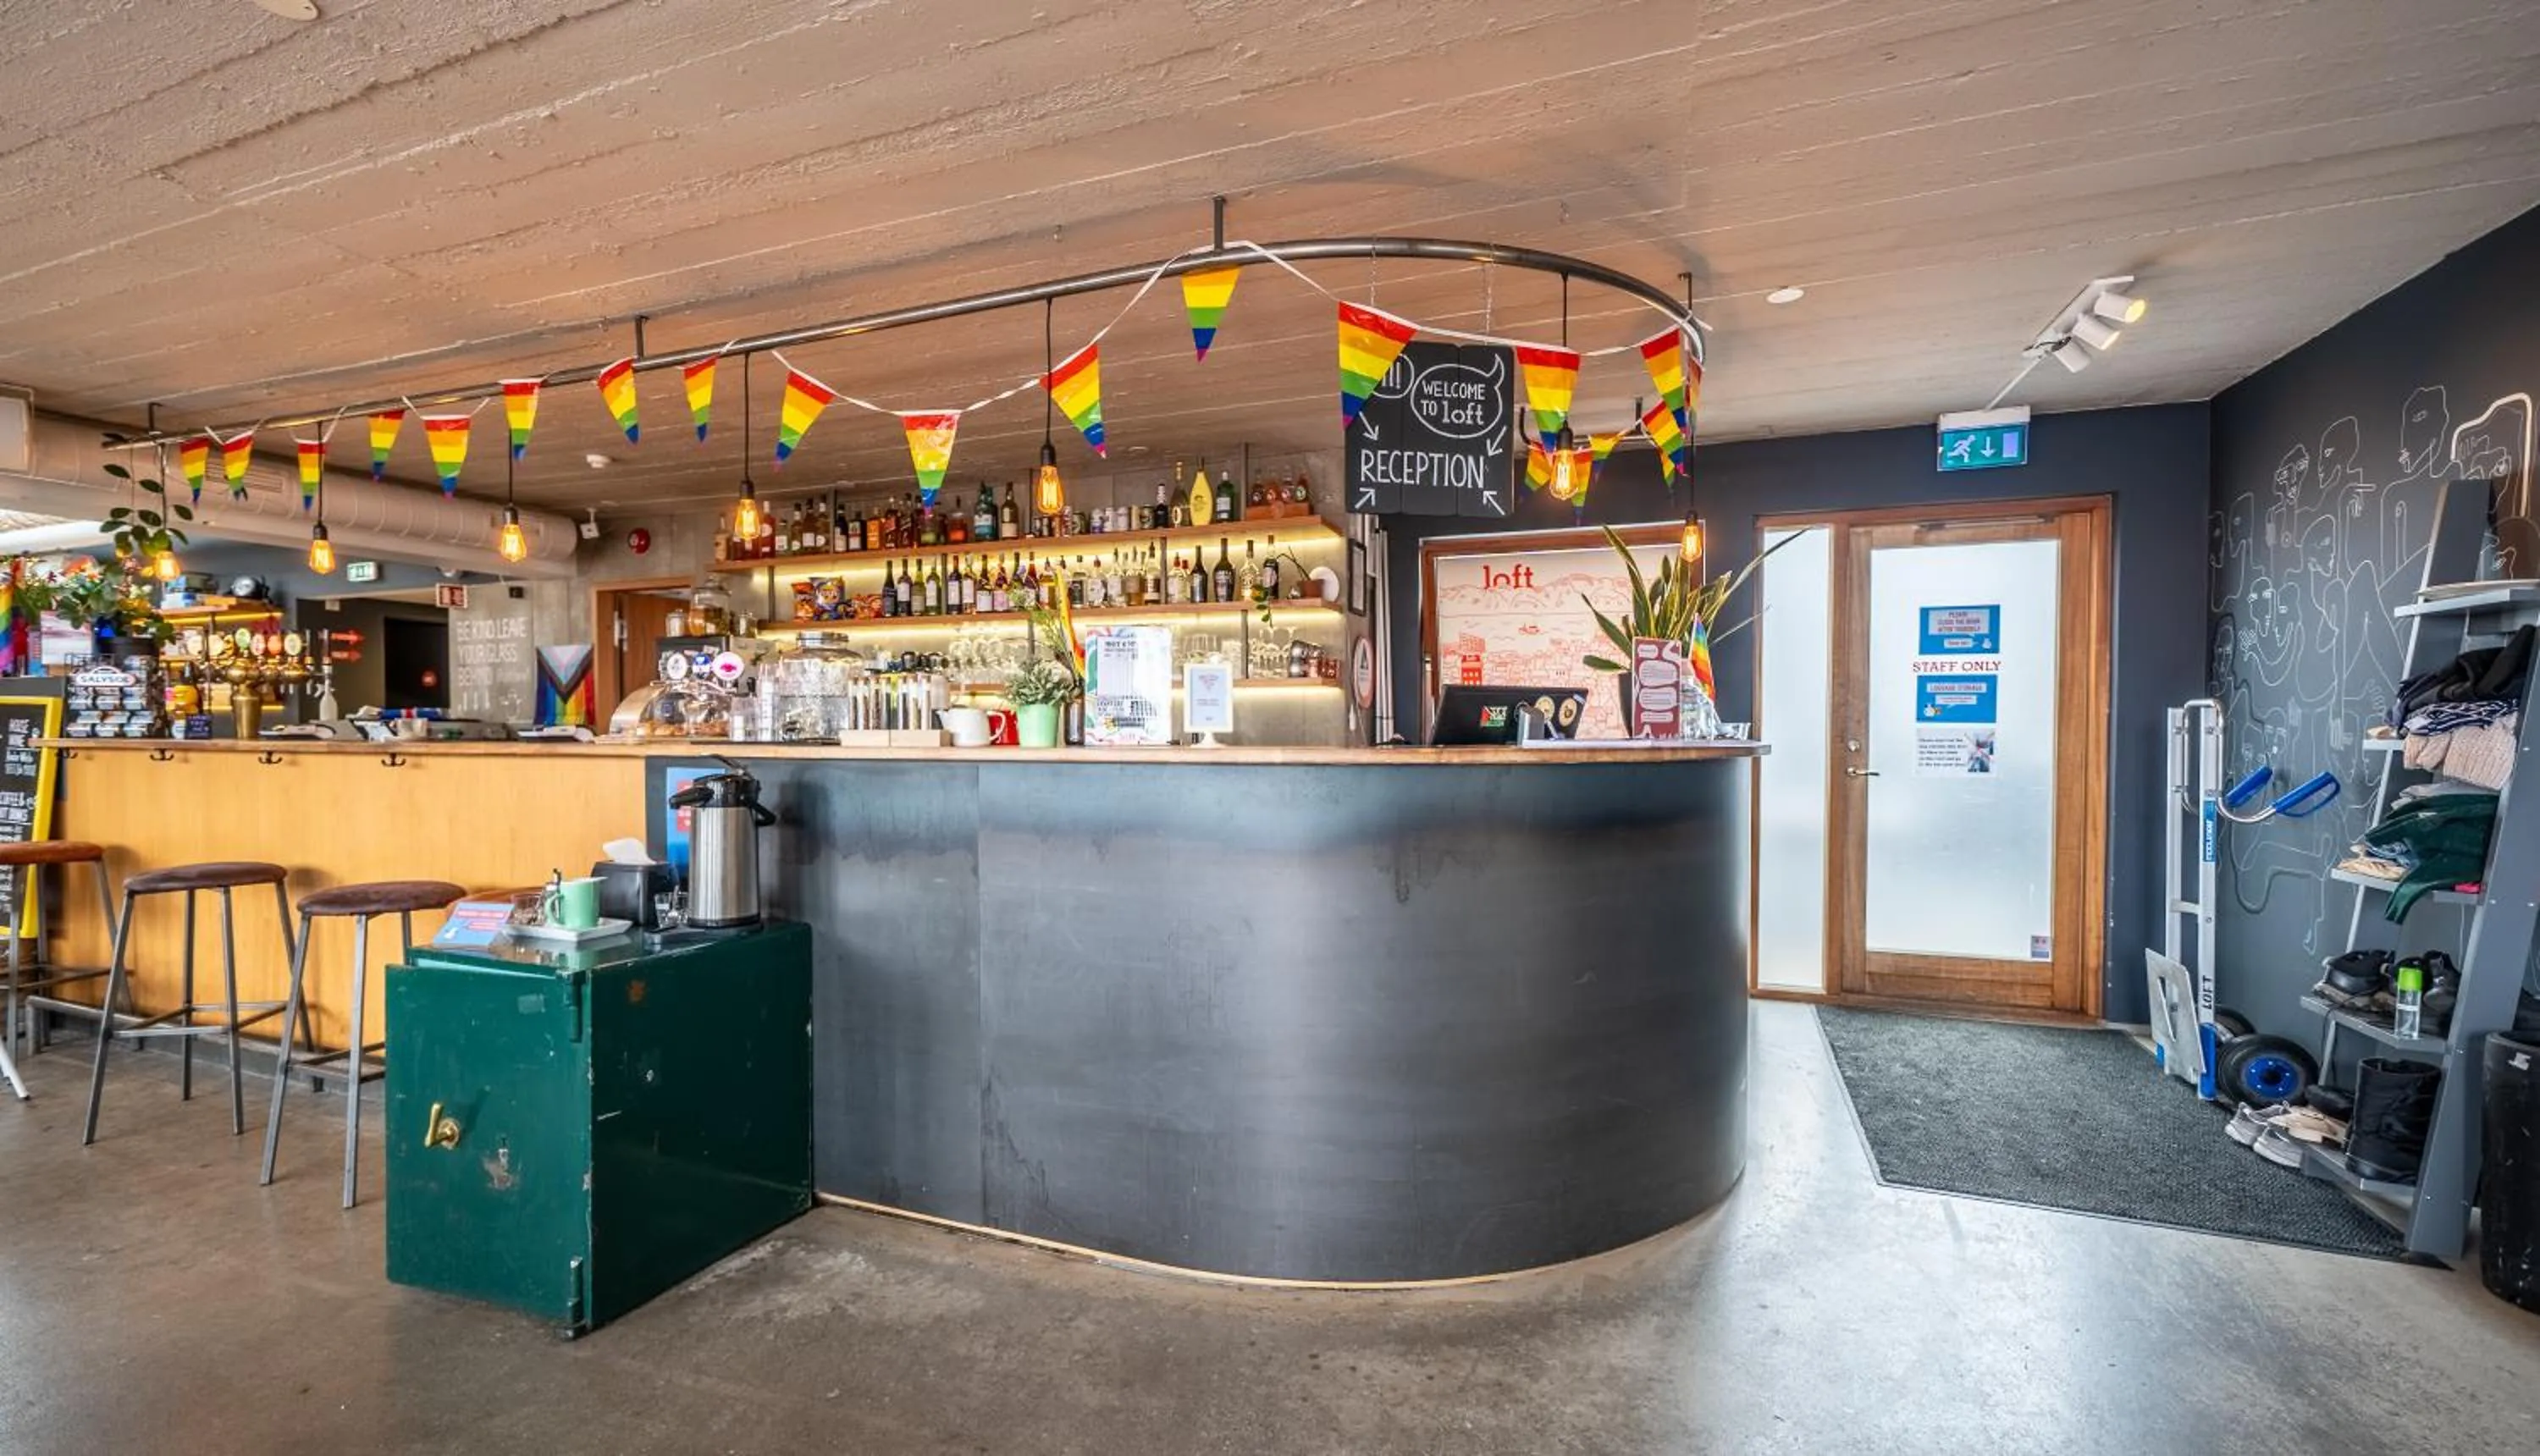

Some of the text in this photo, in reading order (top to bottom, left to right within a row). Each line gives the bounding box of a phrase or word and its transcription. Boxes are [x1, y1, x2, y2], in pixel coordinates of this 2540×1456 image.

[1422, 380, 1486, 400] WELCOME
[1421, 400, 1484, 426] TO loft
[1360, 449, 1485, 489] RECEPTION
[1483, 563, 1534, 590] loft
[496, 617, 529, 639] LEAVE
[457, 643, 518, 665] YOUR GLASS
[1913, 660, 2002, 673] STAFF ONLY
[2202, 974, 2213, 1010] LOFT
